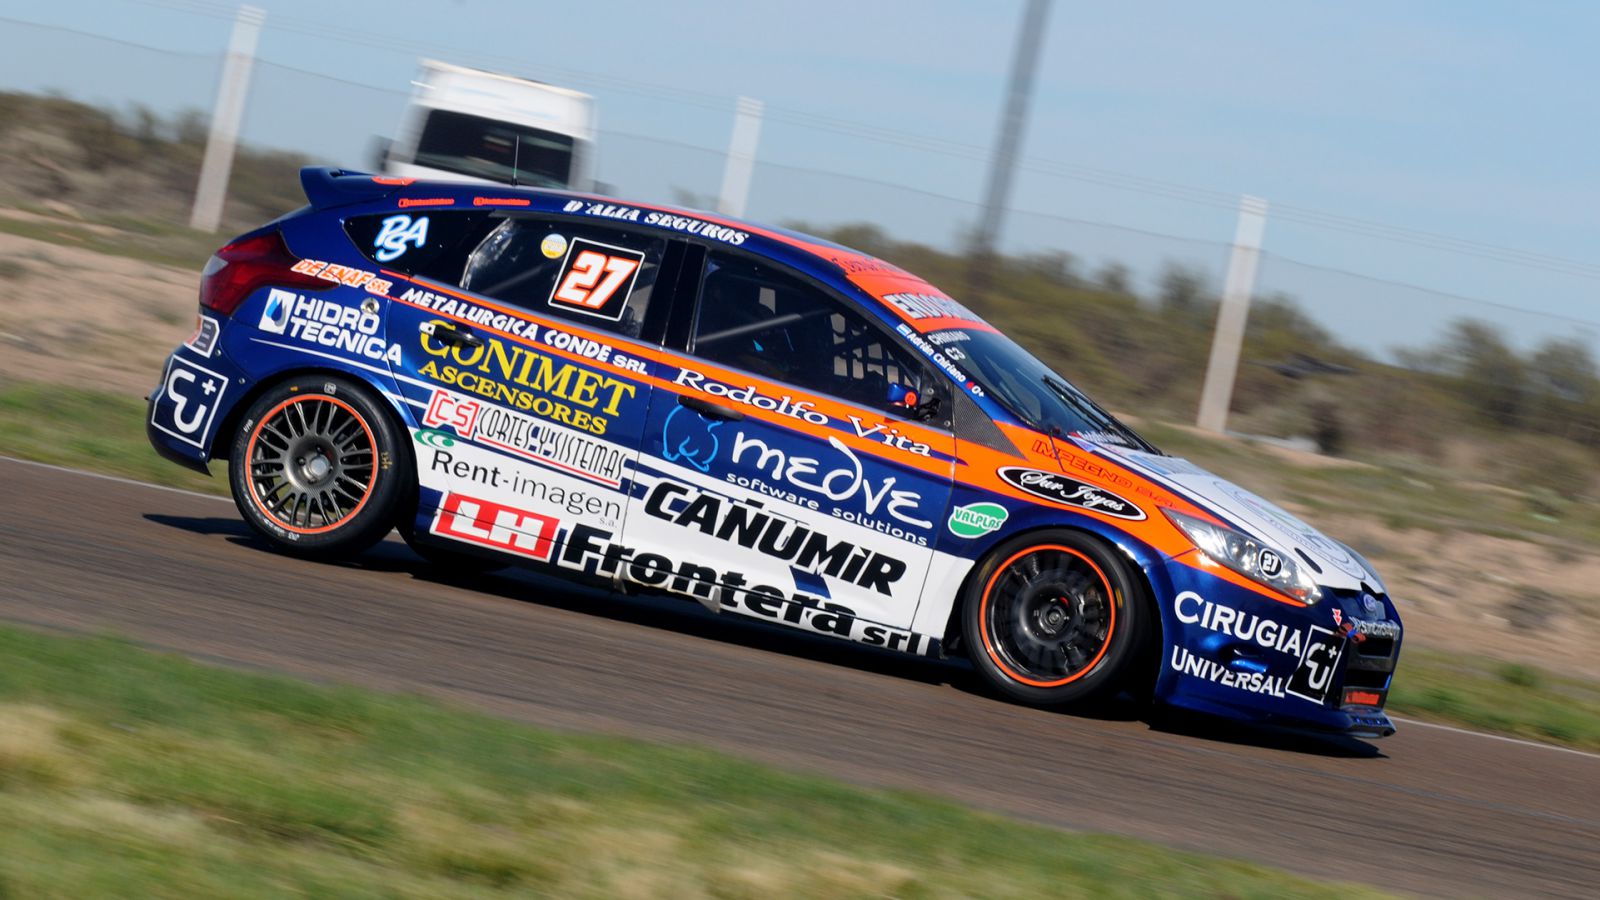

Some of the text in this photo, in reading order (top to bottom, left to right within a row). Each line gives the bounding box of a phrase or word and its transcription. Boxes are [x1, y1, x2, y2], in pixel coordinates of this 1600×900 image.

[644, 210, 750, 247] SEGUROS
[553, 249, 640, 310] 27
[290, 316, 403, 367] TECNICA
[292, 294, 380, 336] HIDRO
[400, 288, 649, 376] METALURGICA CONDE SRL
[417, 359, 608, 436] ASCENSORES
[420, 319, 637, 418] CONIMET
[478, 406, 534, 450] CORTES
[550, 429, 628, 481] SISTEMAS
[672, 366, 932, 457] Rodolfo Vita
[431, 449, 622, 521] Rent-imagen
[726, 471, 928, 547] software solutions
[954, 507, 1002, 530] VALPLAS
[450, 499, 544, 552] LH
[561, 523, 922, 655] Frontera srl
[1260, 553, 1279, 572] 27
[1174, 590, 1302, 658] CIRUGIA
[1170, 644, 1286, 698] UNIVERSAL
